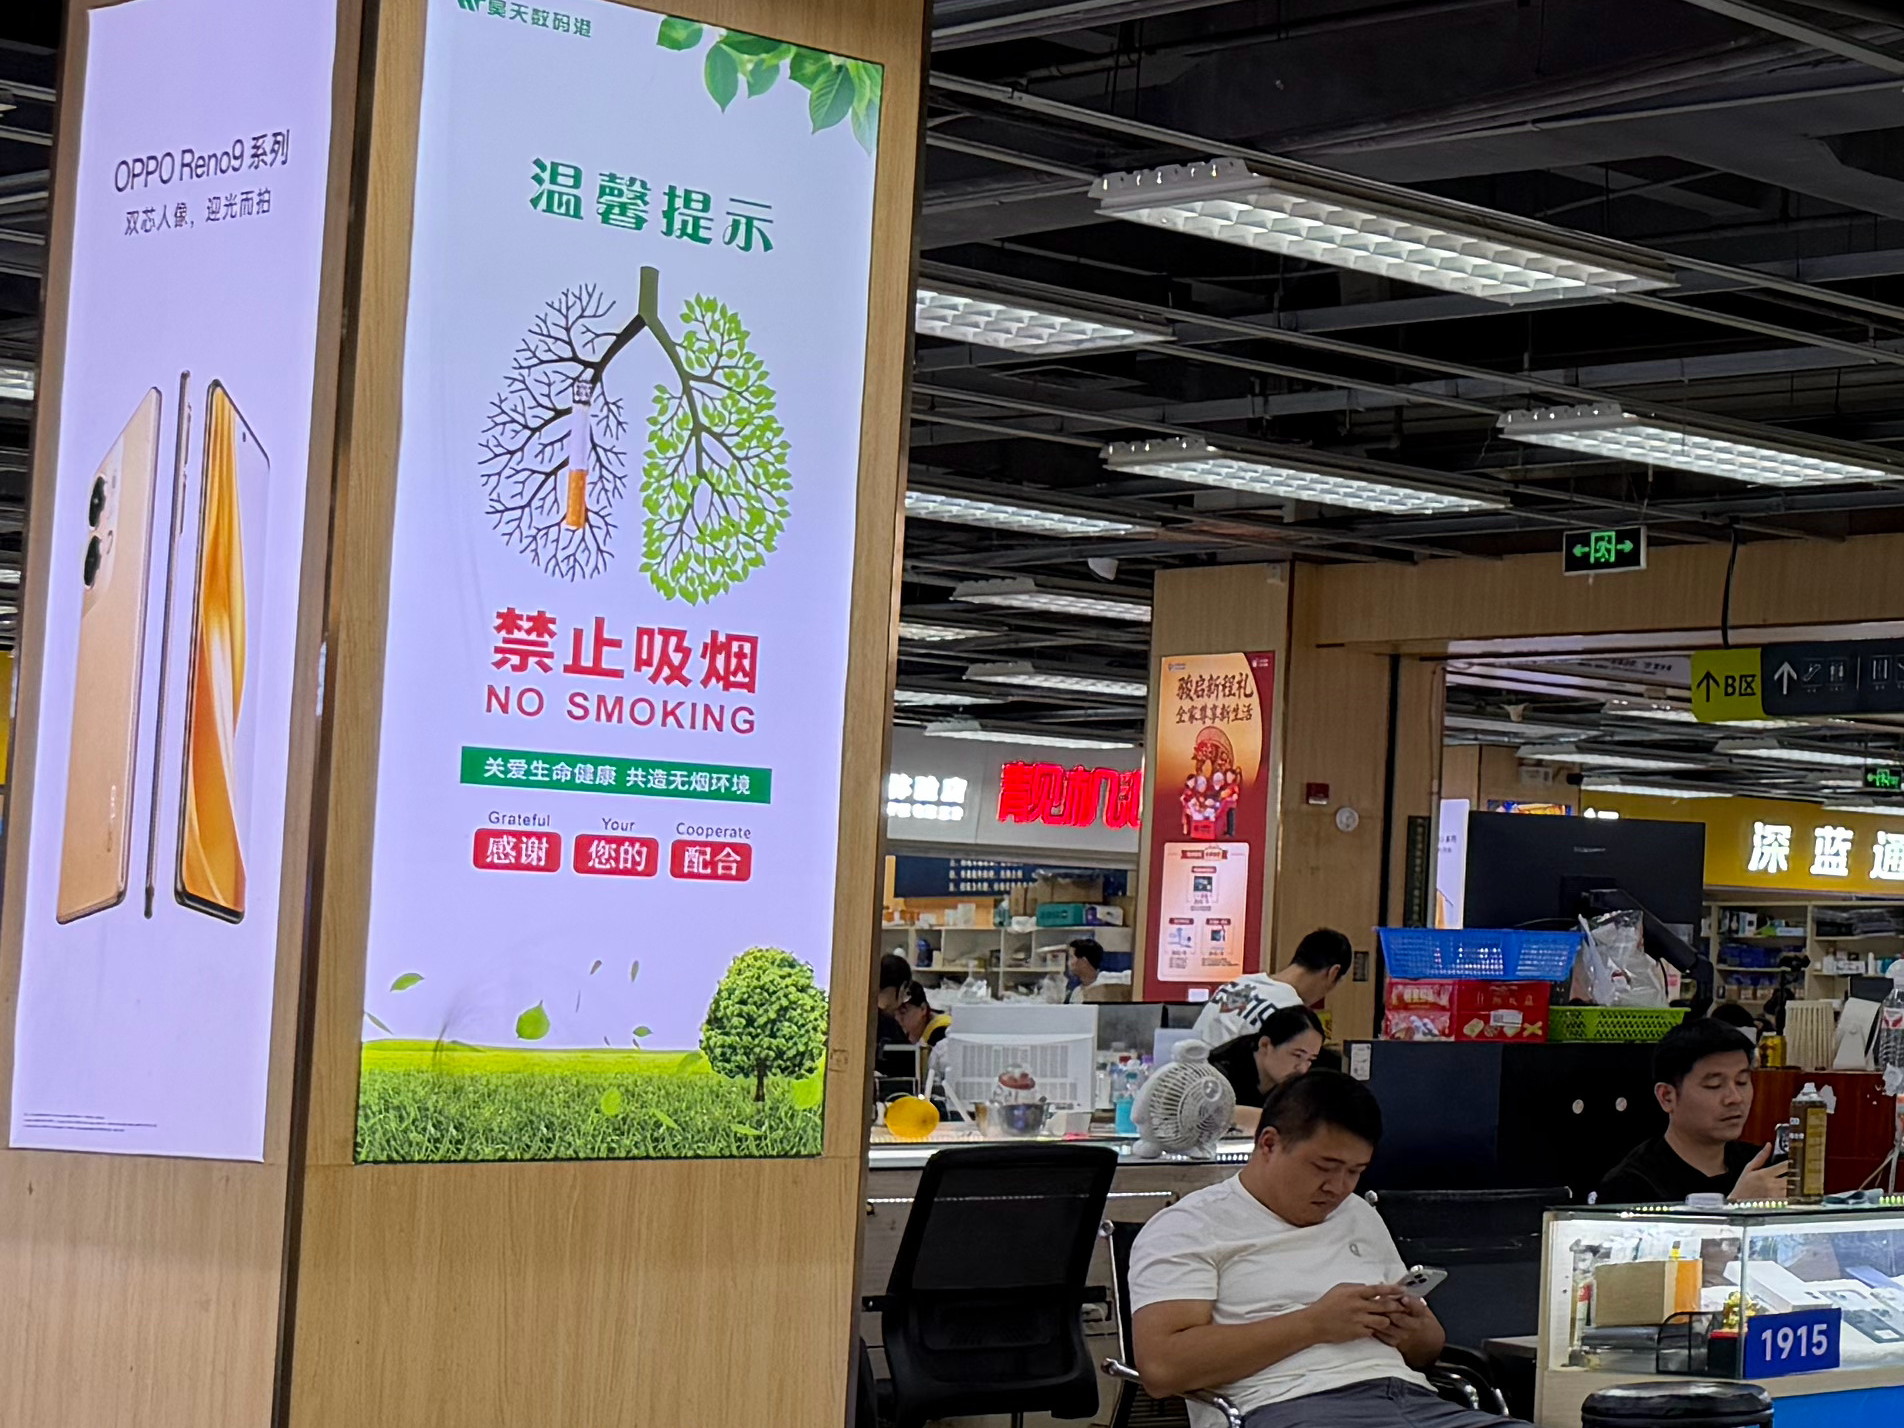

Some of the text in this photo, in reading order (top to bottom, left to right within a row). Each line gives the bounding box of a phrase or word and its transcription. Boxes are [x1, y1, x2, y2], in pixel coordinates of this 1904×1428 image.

[115, 129, 290, 192] OPPO Reno9 系列
[528, 158, 775, 254] 温馨提示
[491, 607, 759, 694] 禁止吸烟
[1724, 674, 1756, 697] B区
[485, 684, 756, 734] NO SMOKING
[484, 757, 751, 796] 关爱生命健康 共造无烟环境
[487, 811, 752, 842] Grateful Your Cooperate
[485, 835, 742, 876] 感谢 您的 配合
[1761, 1322, 1828, 1362] 1915
